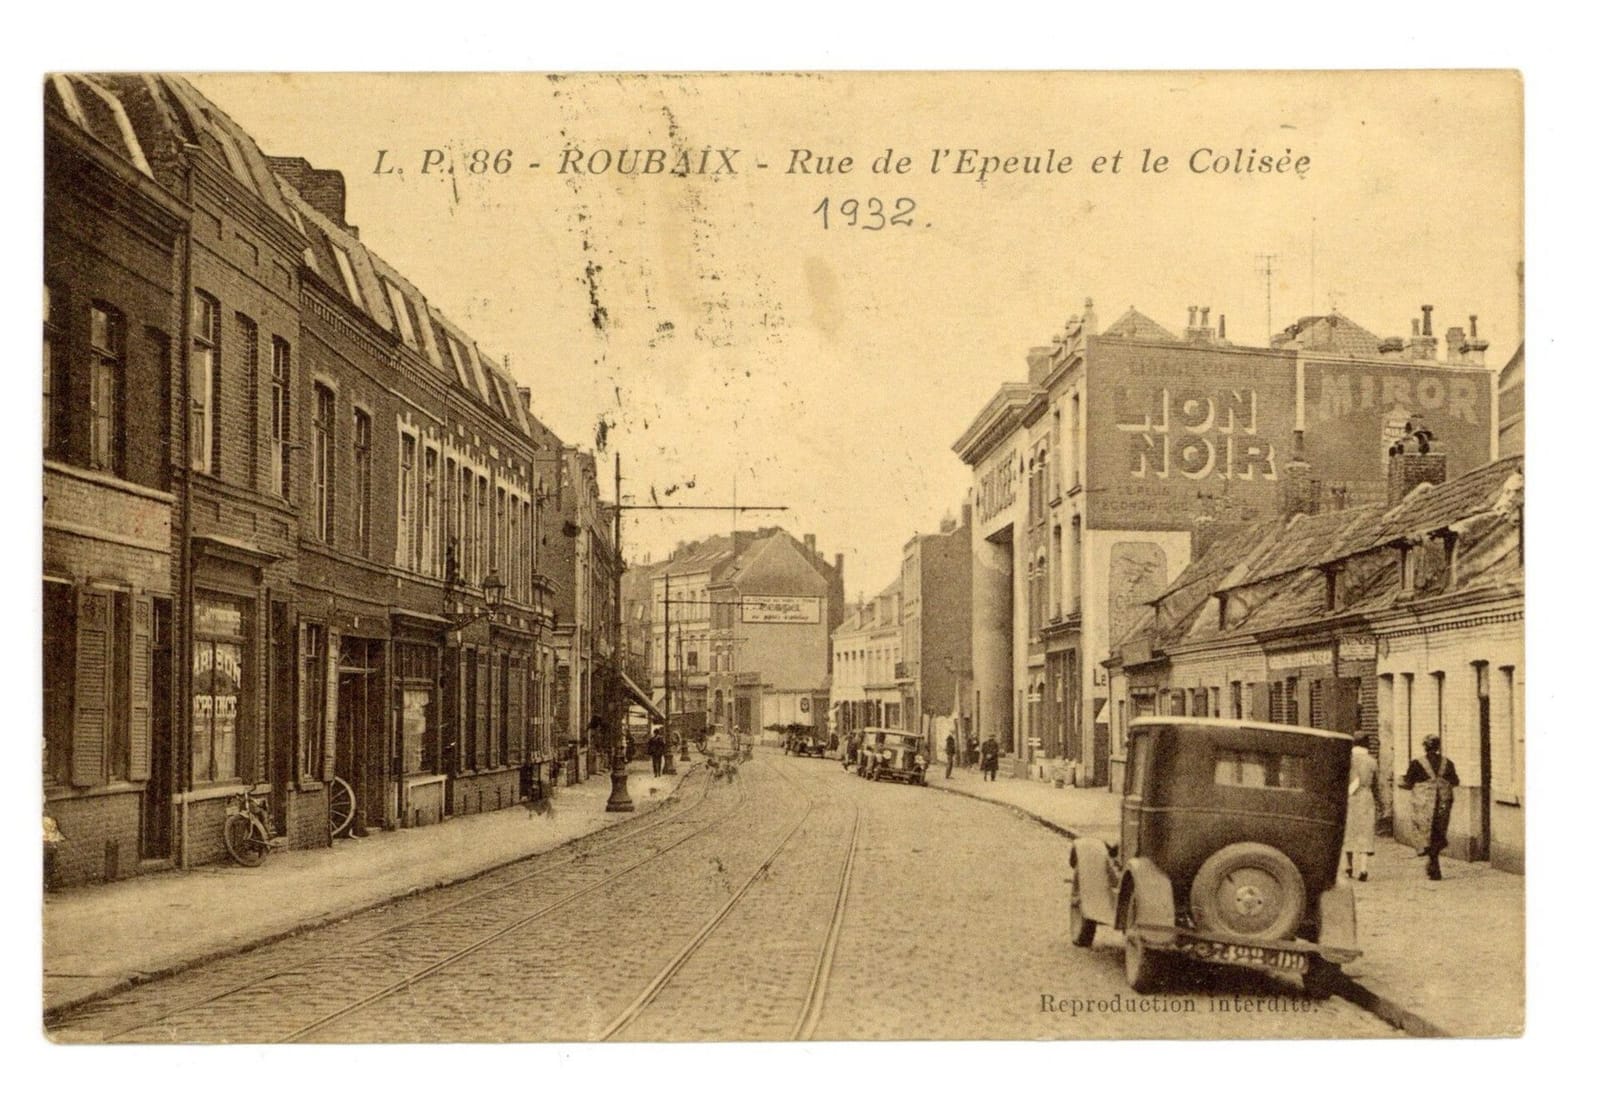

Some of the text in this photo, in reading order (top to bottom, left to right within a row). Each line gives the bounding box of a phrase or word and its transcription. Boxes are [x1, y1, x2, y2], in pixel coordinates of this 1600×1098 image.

[1114, 387, 1257, 435] LION
[1317, 372, 1485, 428] MIROR
[1129, 432, 1278, 482] NOIR
